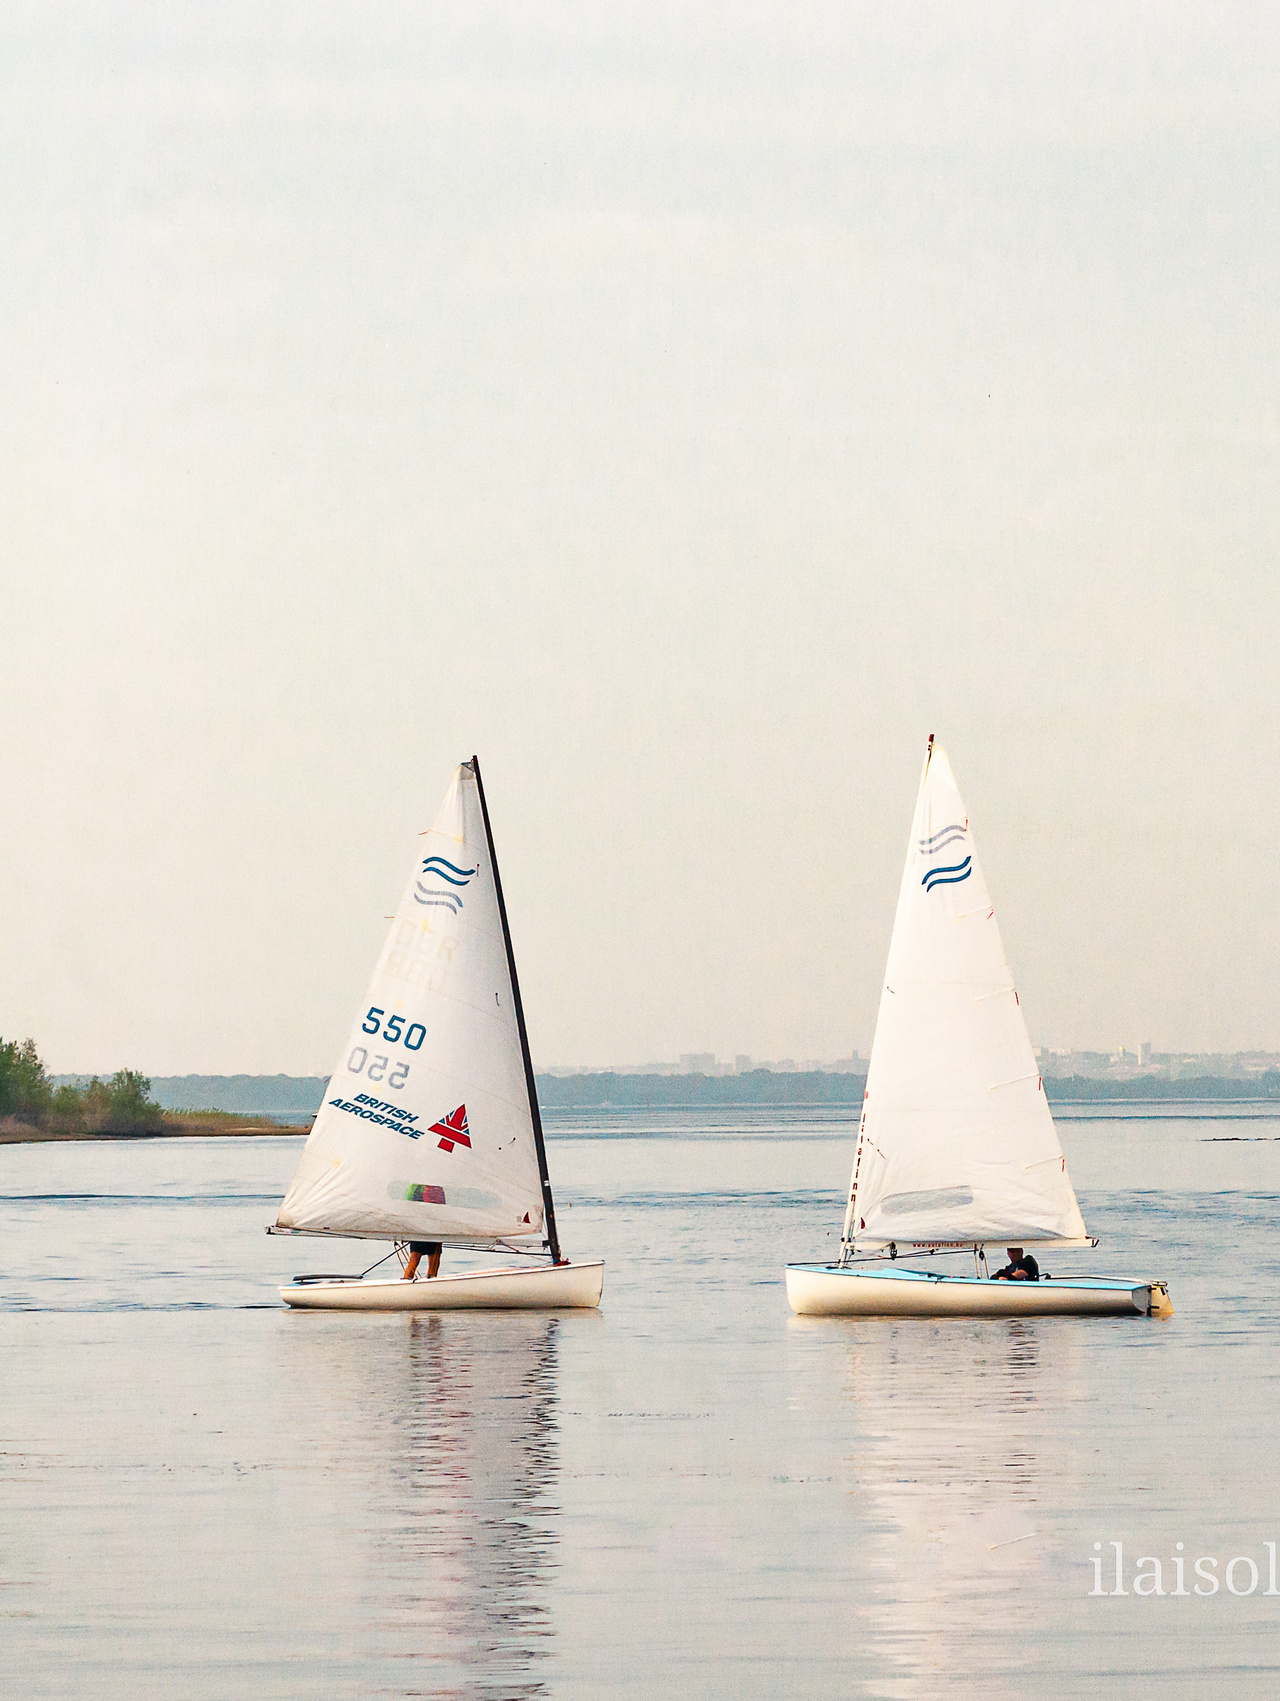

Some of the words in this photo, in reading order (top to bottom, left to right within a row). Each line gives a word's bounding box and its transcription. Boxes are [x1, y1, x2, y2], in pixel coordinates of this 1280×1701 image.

[361, 1006, 427, 1051] 550
[328, 1098, 425, 1140] AEROSPACE
[353, 1093, 420, 1123] BRITISH
